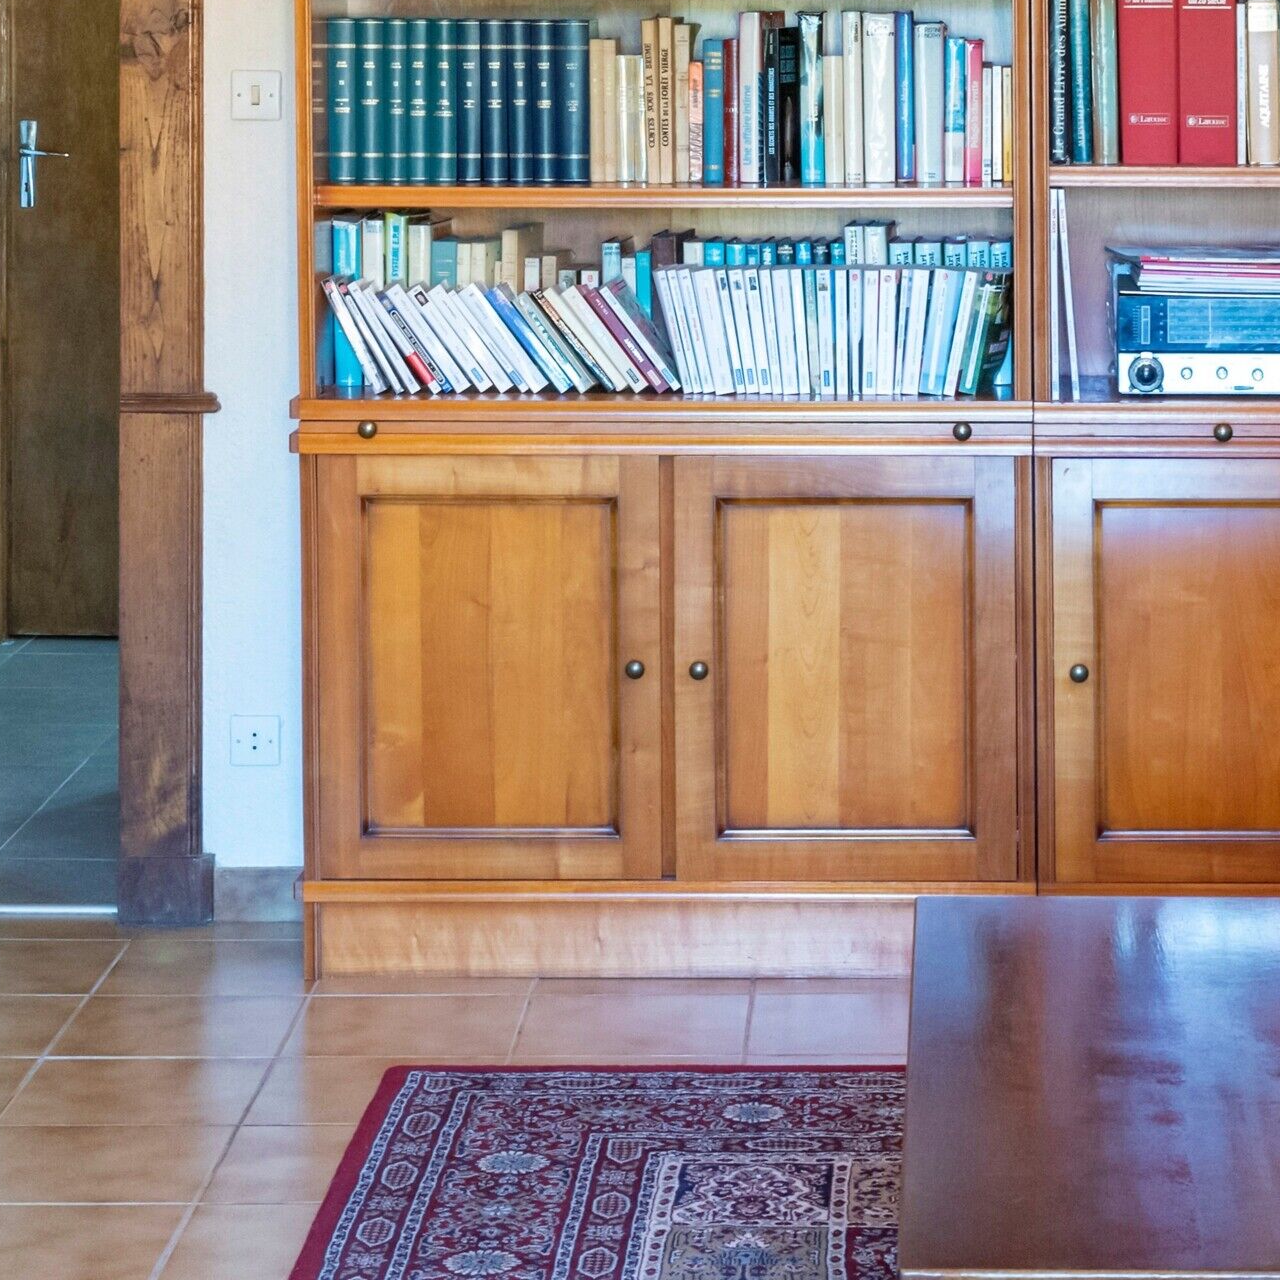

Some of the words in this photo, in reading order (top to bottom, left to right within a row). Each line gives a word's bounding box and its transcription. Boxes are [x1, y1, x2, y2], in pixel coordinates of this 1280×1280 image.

[1055, 35, 1066, 53] des
[646, 75, 653, 86] LA
[660, 77, 668, 100] FORÊT
[1055, 60, 1066, 93] Livre
[743, 85, 751, 114] intime
[1259, 64, 1270, 127] AQUITAINE
[743, 116, 751, 145] affaire
[1053, 97, 1066, 135] Grand
[1053, 138, 1065, 154] Le
